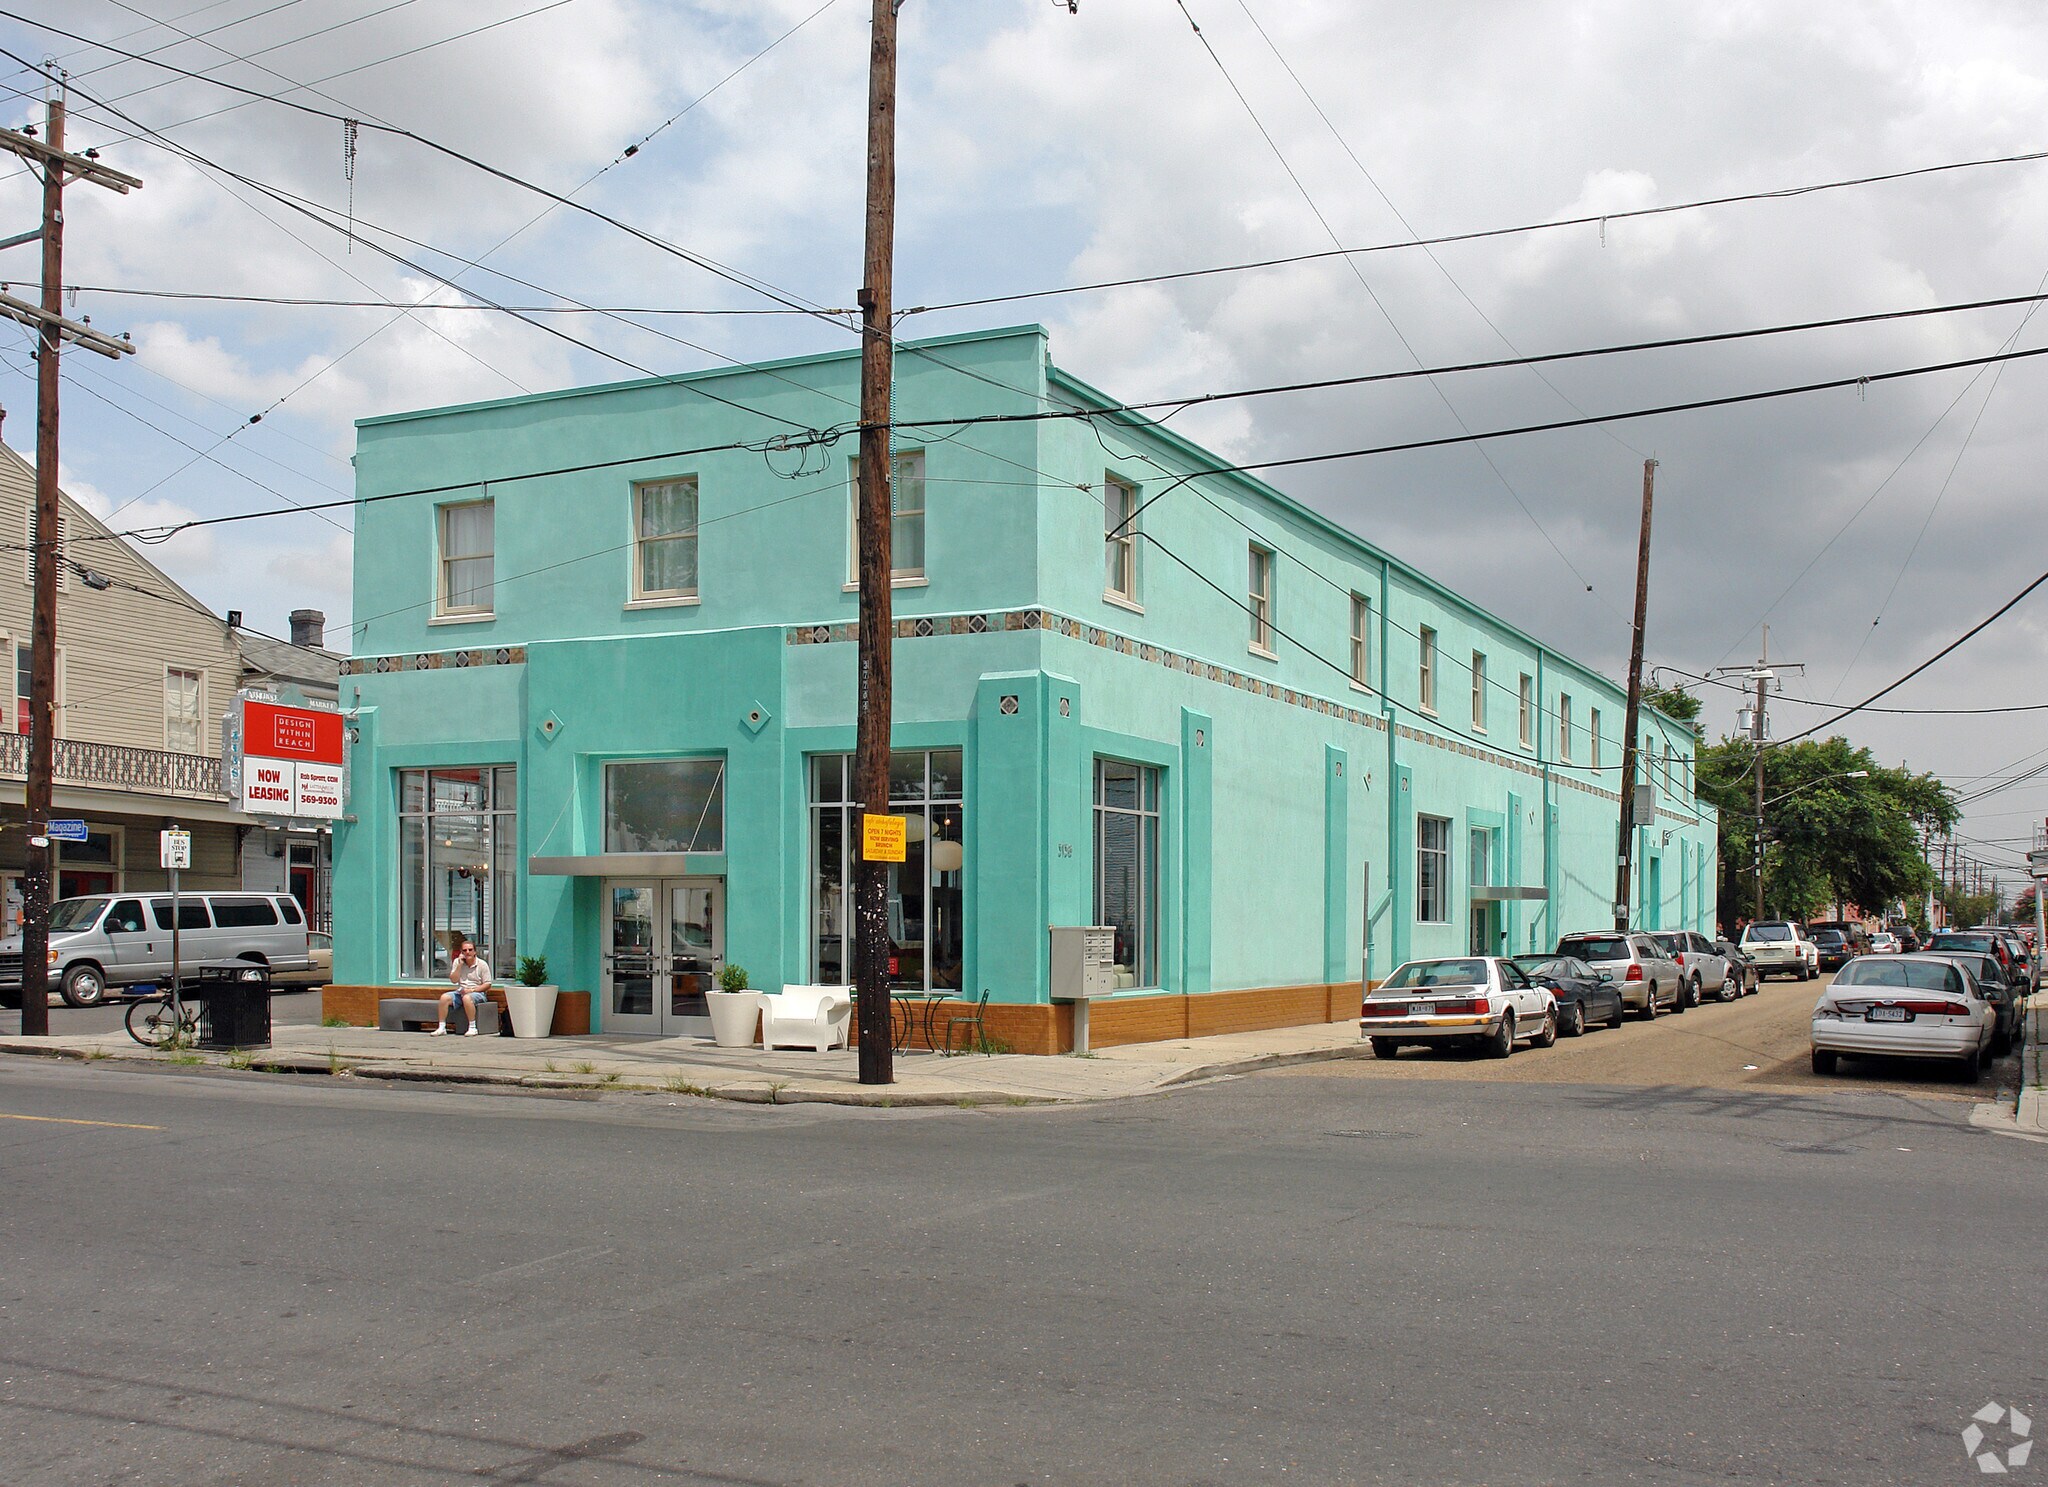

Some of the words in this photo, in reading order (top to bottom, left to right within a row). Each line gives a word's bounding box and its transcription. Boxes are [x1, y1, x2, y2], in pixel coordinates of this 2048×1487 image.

[279, 718, 311, 728] DESIGN
[279, 728, 311, 738] WITHIN
[278, 737, 311, 748] REACH
[257, 769, 281, 783] NOW
[248, 786, 289, 802] LEASING
[301, 794, 338, 805] 569-9300
[49, 821, 82, 834] Magazine
